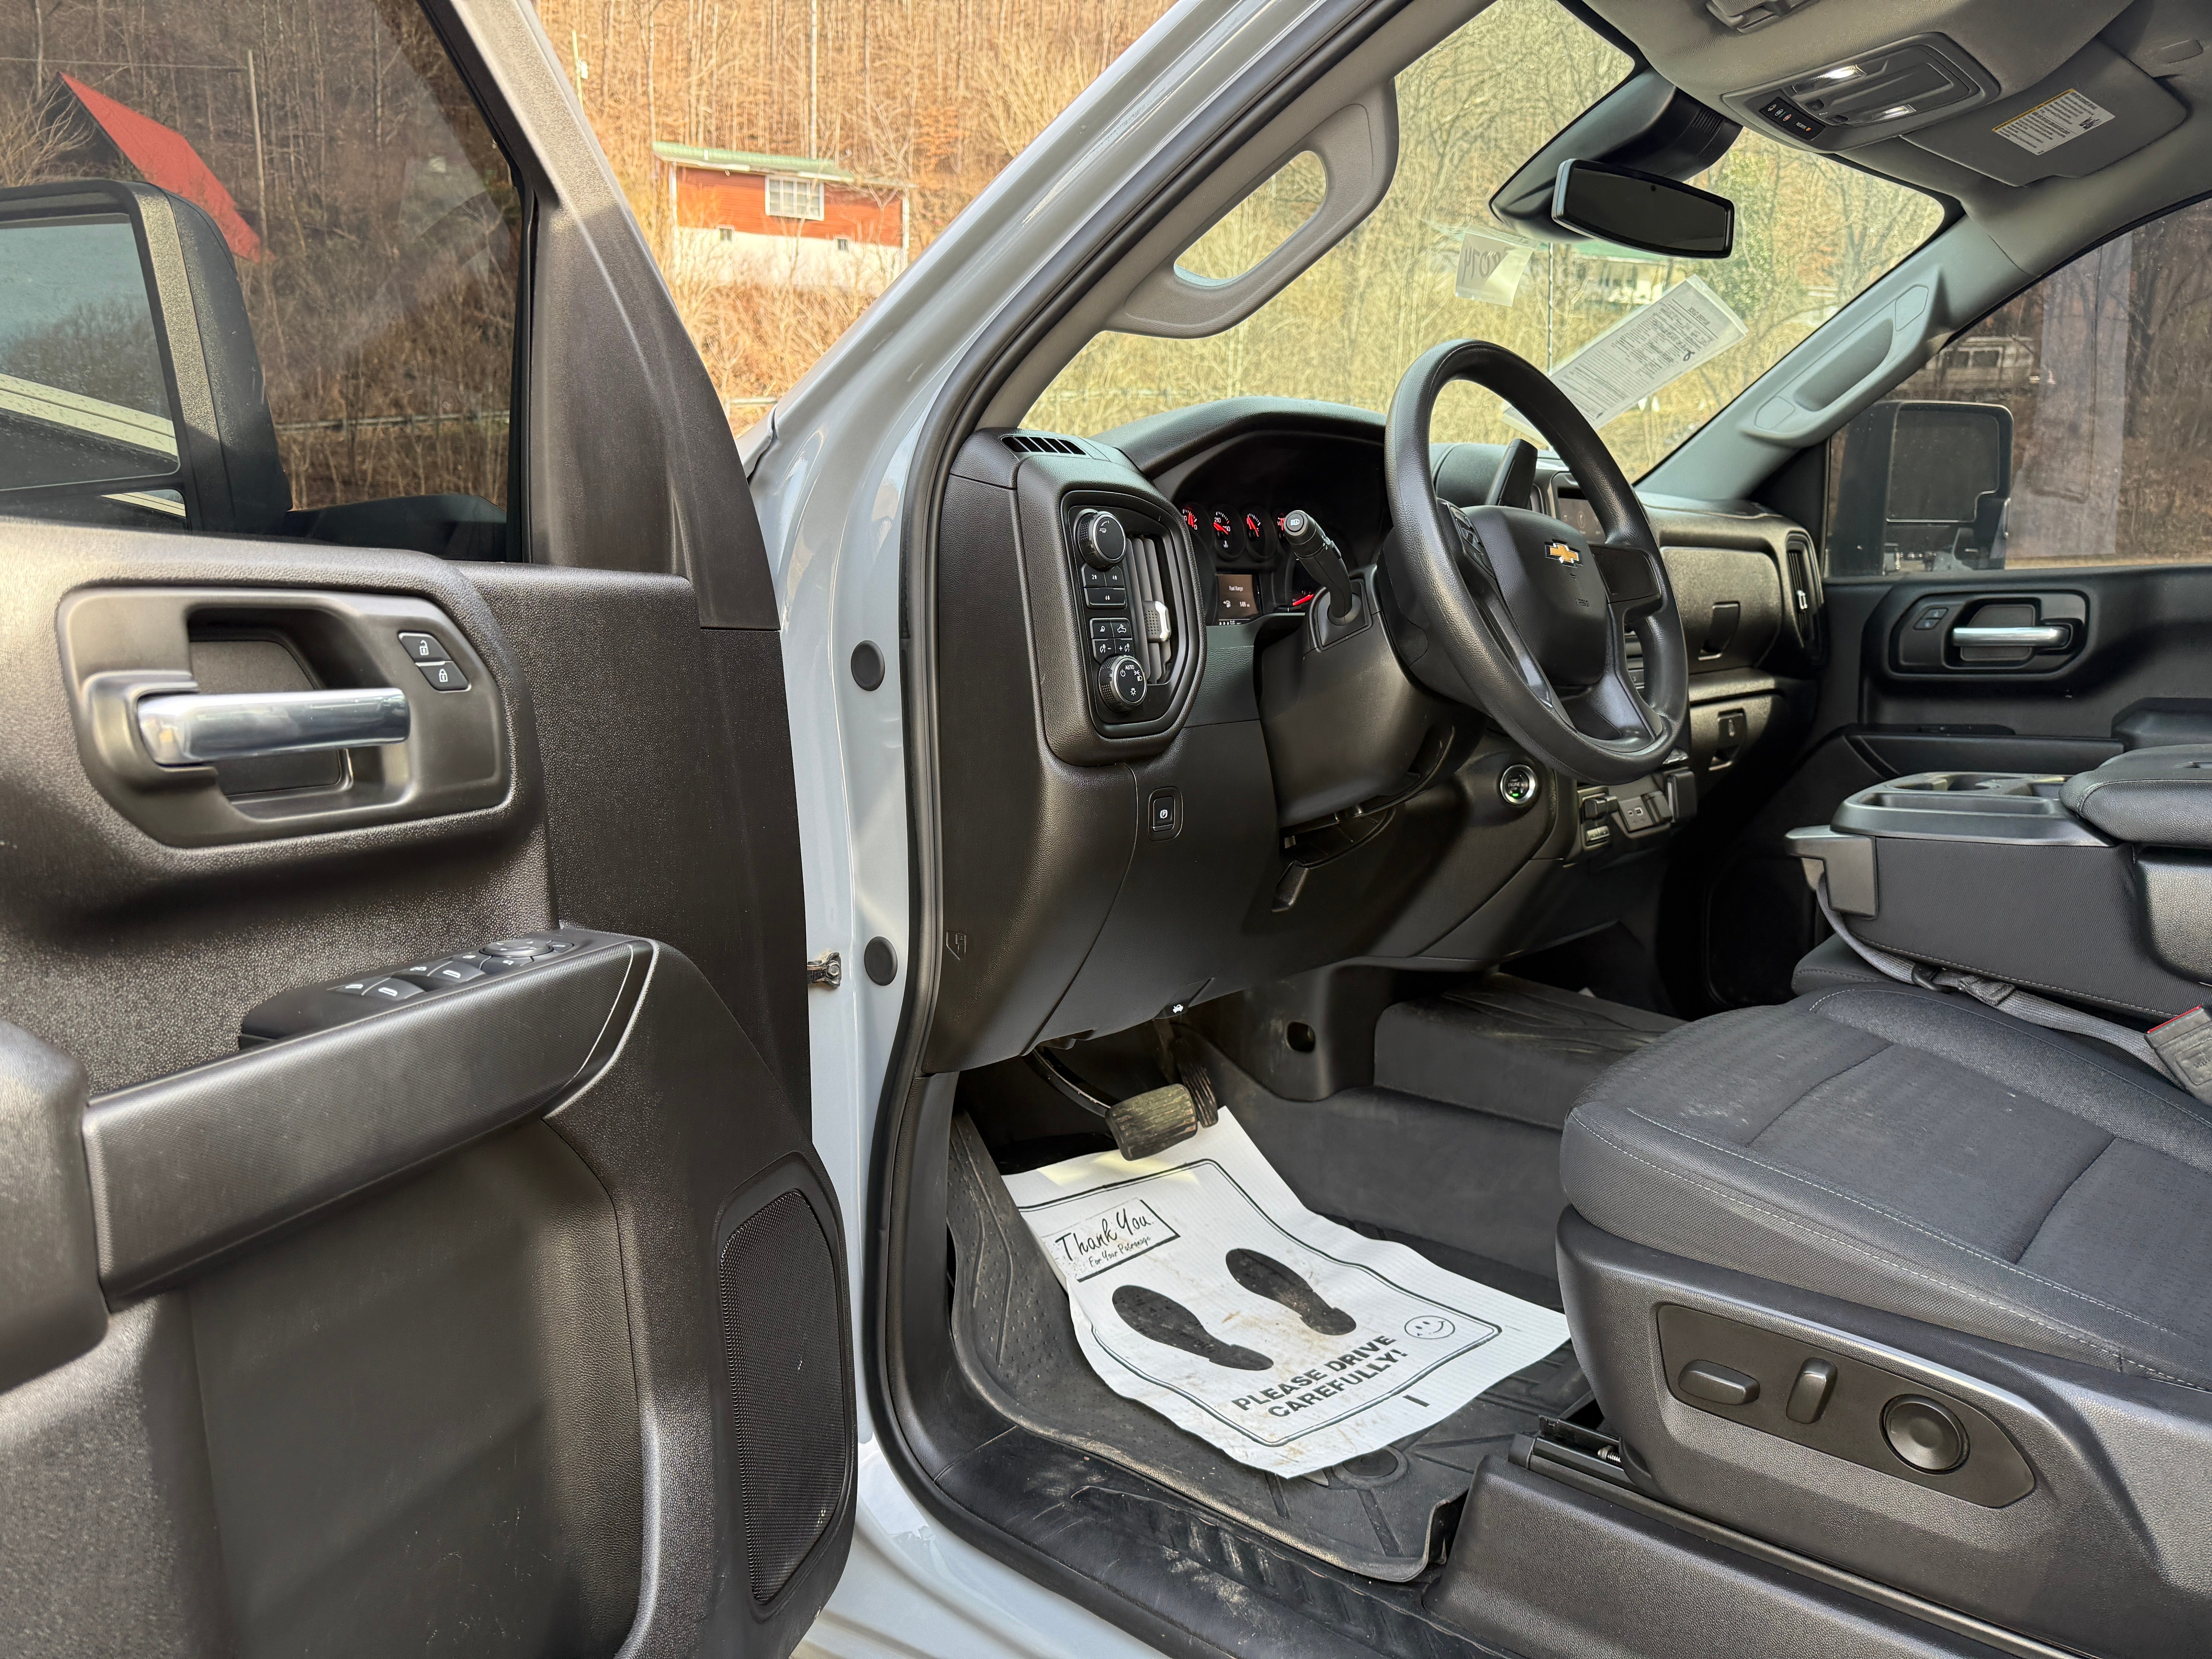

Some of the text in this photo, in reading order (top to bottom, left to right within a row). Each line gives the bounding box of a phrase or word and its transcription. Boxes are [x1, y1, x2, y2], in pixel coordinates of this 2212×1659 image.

[1055, 1208, 1151, 1261] Thank You
[1089, 1236, 1151, 1267] For Your Patronage
[1231, 1335, 1396, 1411] PLEASE DRIVE
[1268, 1348, 1408, 1417] CAREFULLY!
